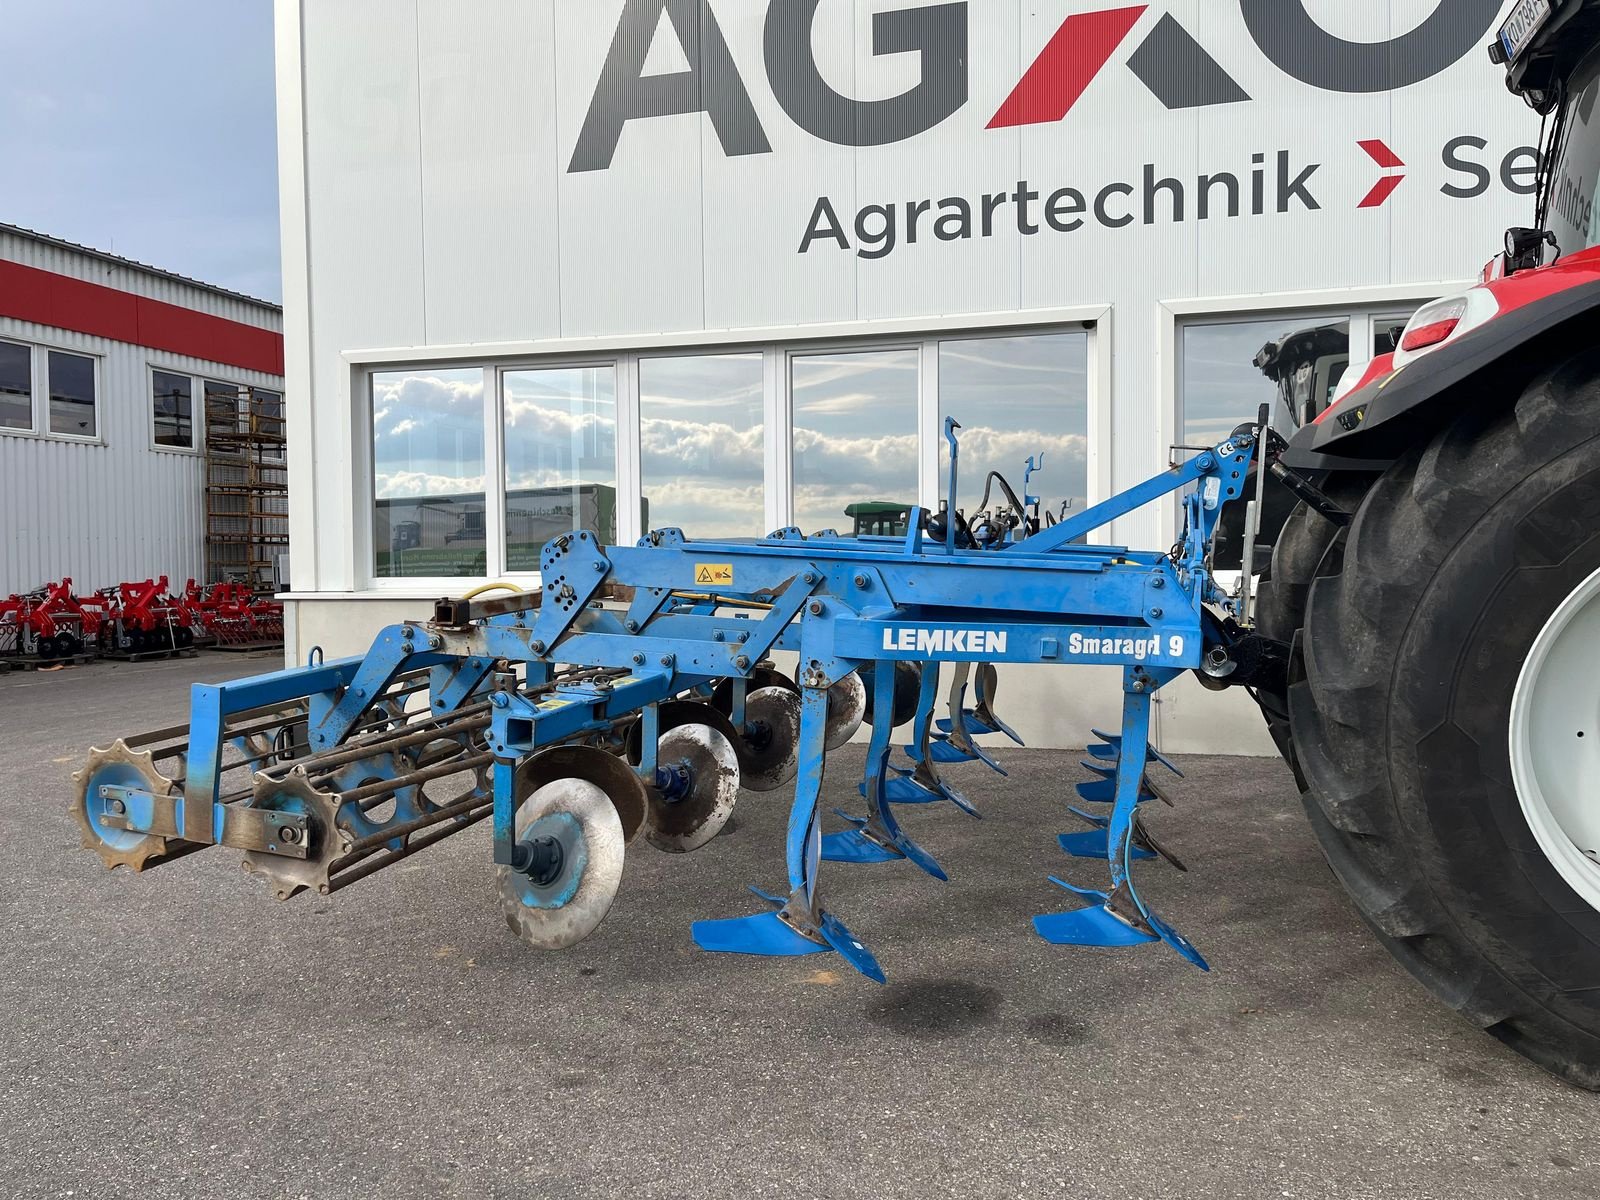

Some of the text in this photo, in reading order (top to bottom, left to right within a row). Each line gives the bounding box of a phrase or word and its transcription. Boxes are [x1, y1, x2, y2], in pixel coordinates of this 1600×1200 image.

[1518, 0, 1545, 33] 798
[798, 150, 1321, 259] Agrartechnik
[1220, 443, 1234, 455] CE
[882, 628, 1006, 657] LEMKEN
[1069, 632, 1185, 660] Smaragd 9
